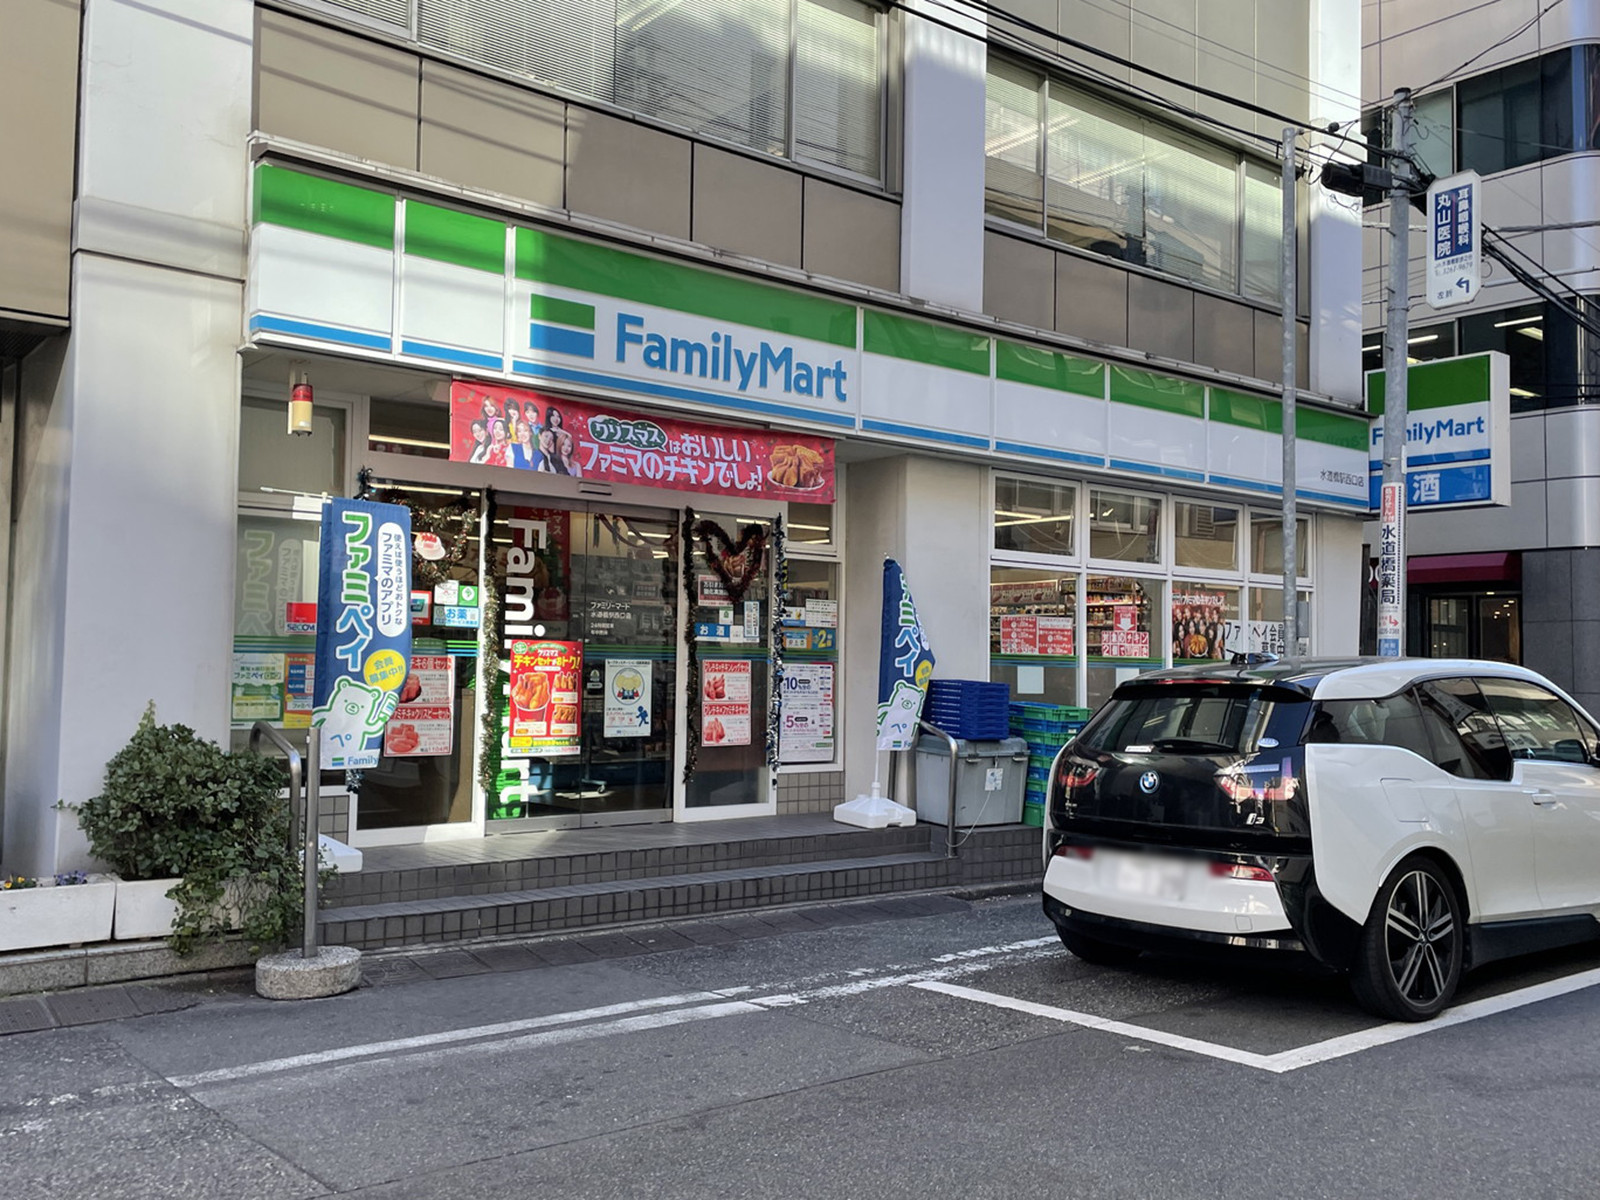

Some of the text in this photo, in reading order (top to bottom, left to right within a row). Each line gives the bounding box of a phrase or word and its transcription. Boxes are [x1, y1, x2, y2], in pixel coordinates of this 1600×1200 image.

[1437, 194, 1451, 258] 丸山医院
[616, 312, 847, 402] FamilyMart
[1372, 416, 1485, 446] FilyMart
[579, 441, 762, 491] ファミマのチキンでしょ!
[1320, 469, 1364, 487] 水道橋駅西口店
[1413, 473, 1440, 502] 酒
[337, 512, 373, 671] ファミペイ
[381, 532, 394, 626] ファミマのアプリ
[394, 533, 404, 626] 使えば使うほどおトクな
[1381, 525, 1396, 604] 水道橋薬局
[590, 601, 631, 610] ファミリーマート
[1246, 813, 1265, 825] i3
